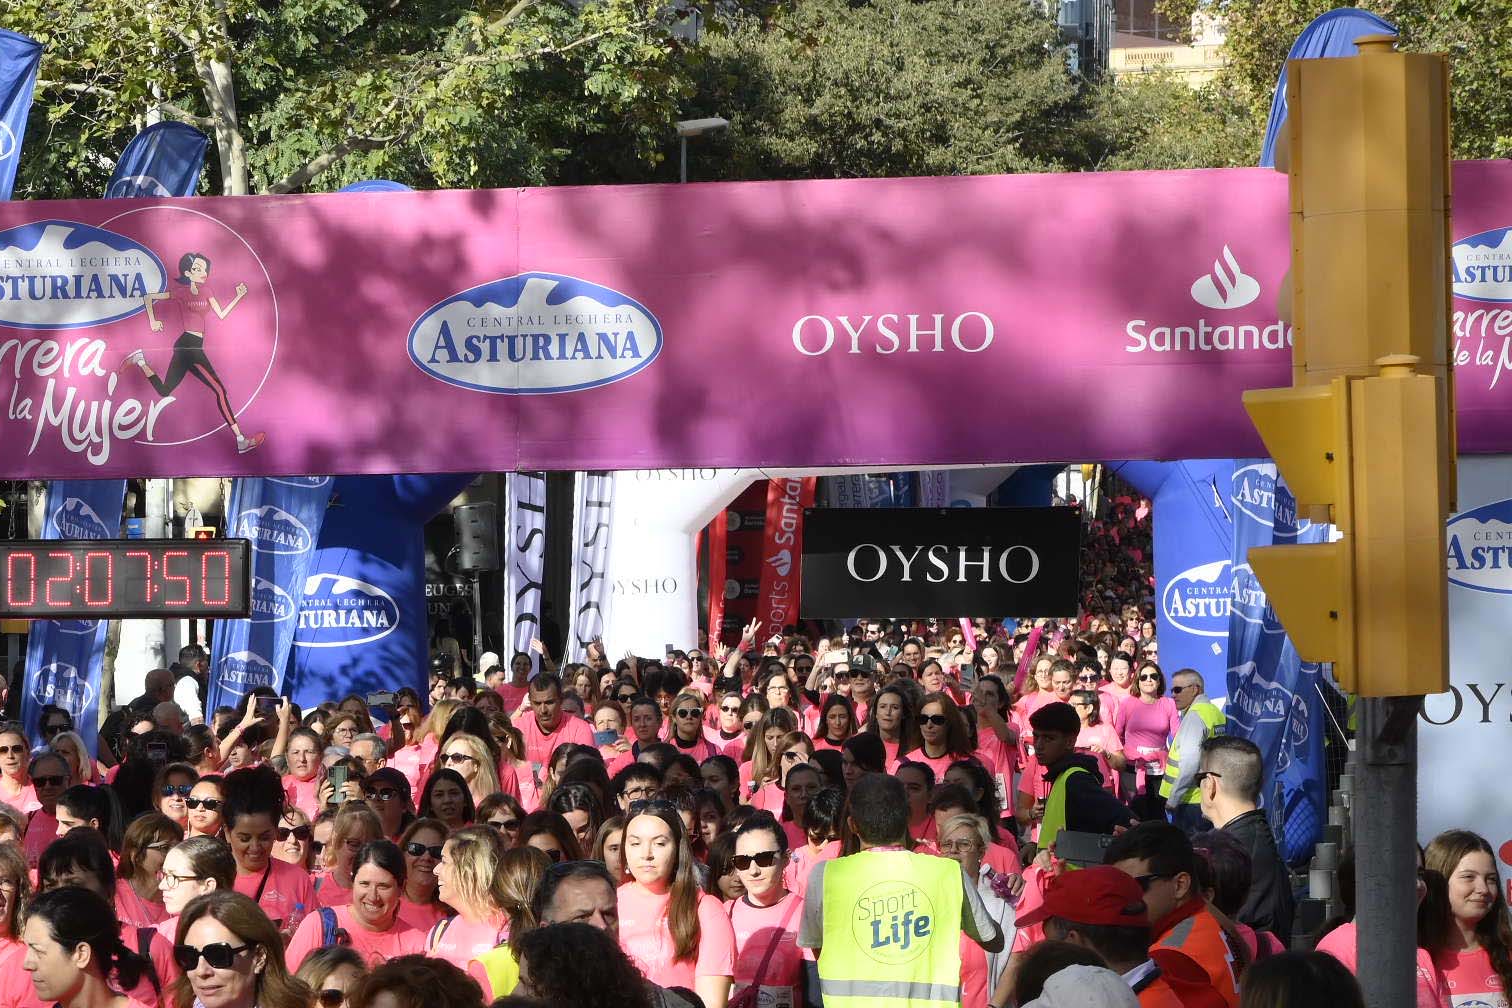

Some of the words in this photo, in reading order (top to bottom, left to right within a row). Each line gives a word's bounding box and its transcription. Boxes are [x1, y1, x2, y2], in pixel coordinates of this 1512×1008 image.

[70, 255, 142, 267] LECHERA
[1467, 253, 1511, 261] CENTRA
[467, 314, 546, 328] CENTRAL
[554, 312, 634, 325] LECHERA
[793, 311, 994, 356] OYSHO
[427, 320, 642, 364] ASTURIANA
[1475, 338, 1494, 366] la
[9, 381, 32, 420] la
[28, 372, 176, 466] Mujer
[1474, 532, 1512, 540] CENT
[577, 472, 611, 648] OYSH
[847, 543, 1040, 584] OYSHO
[7, 551, 231, 607] 02:07:50
[1187, 586, 1229, 595] CENTRA
[299, 609, 389, 629] TURIANA
[858, 889, 918, 921] Sport
[870, 910, 931, 950] Life
